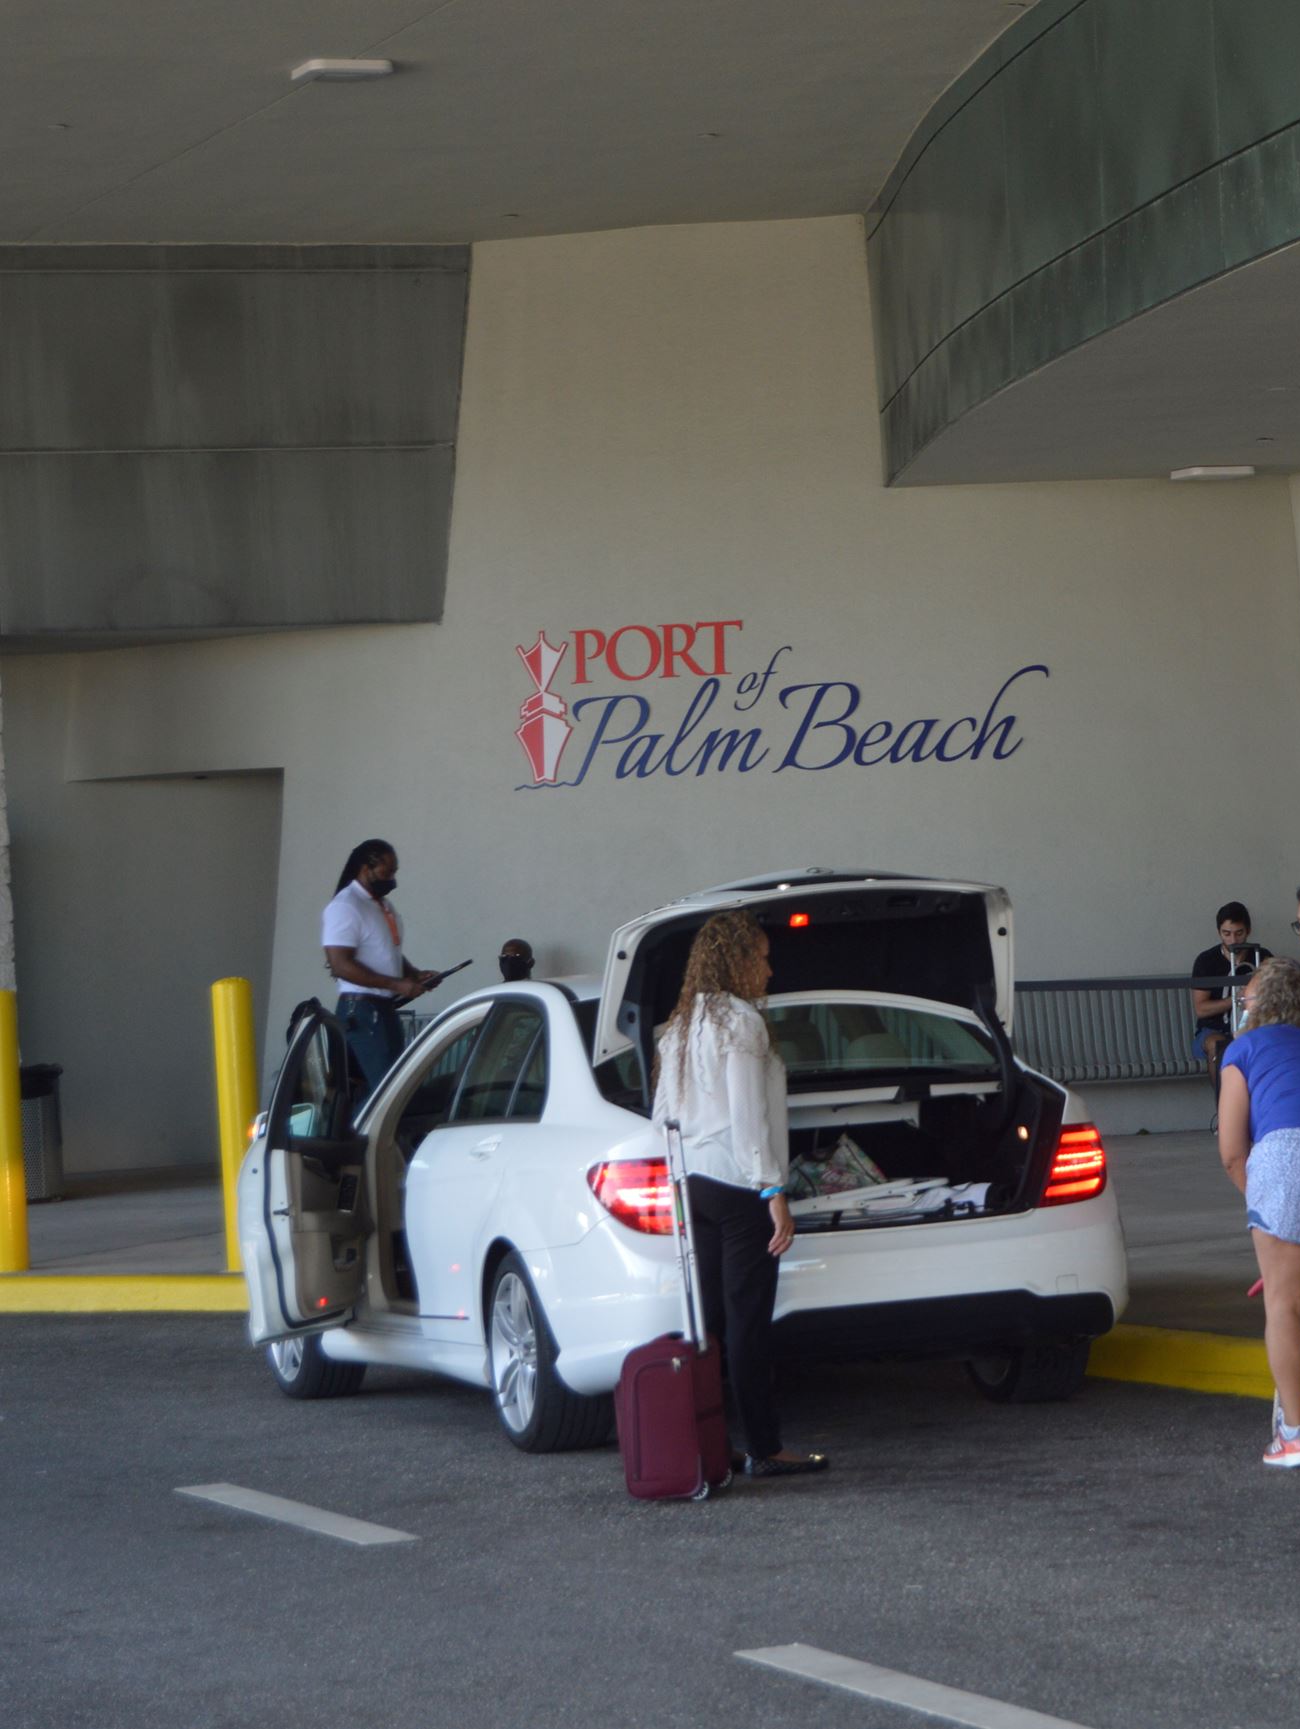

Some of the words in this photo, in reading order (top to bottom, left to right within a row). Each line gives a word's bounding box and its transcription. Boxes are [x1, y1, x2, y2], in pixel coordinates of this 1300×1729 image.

[569, 620, 743, 685] PORT
[734, 645, 793, 711] of
[572, 677, 770, 787] Palm
[772, 664, 1049, 773] Beach
